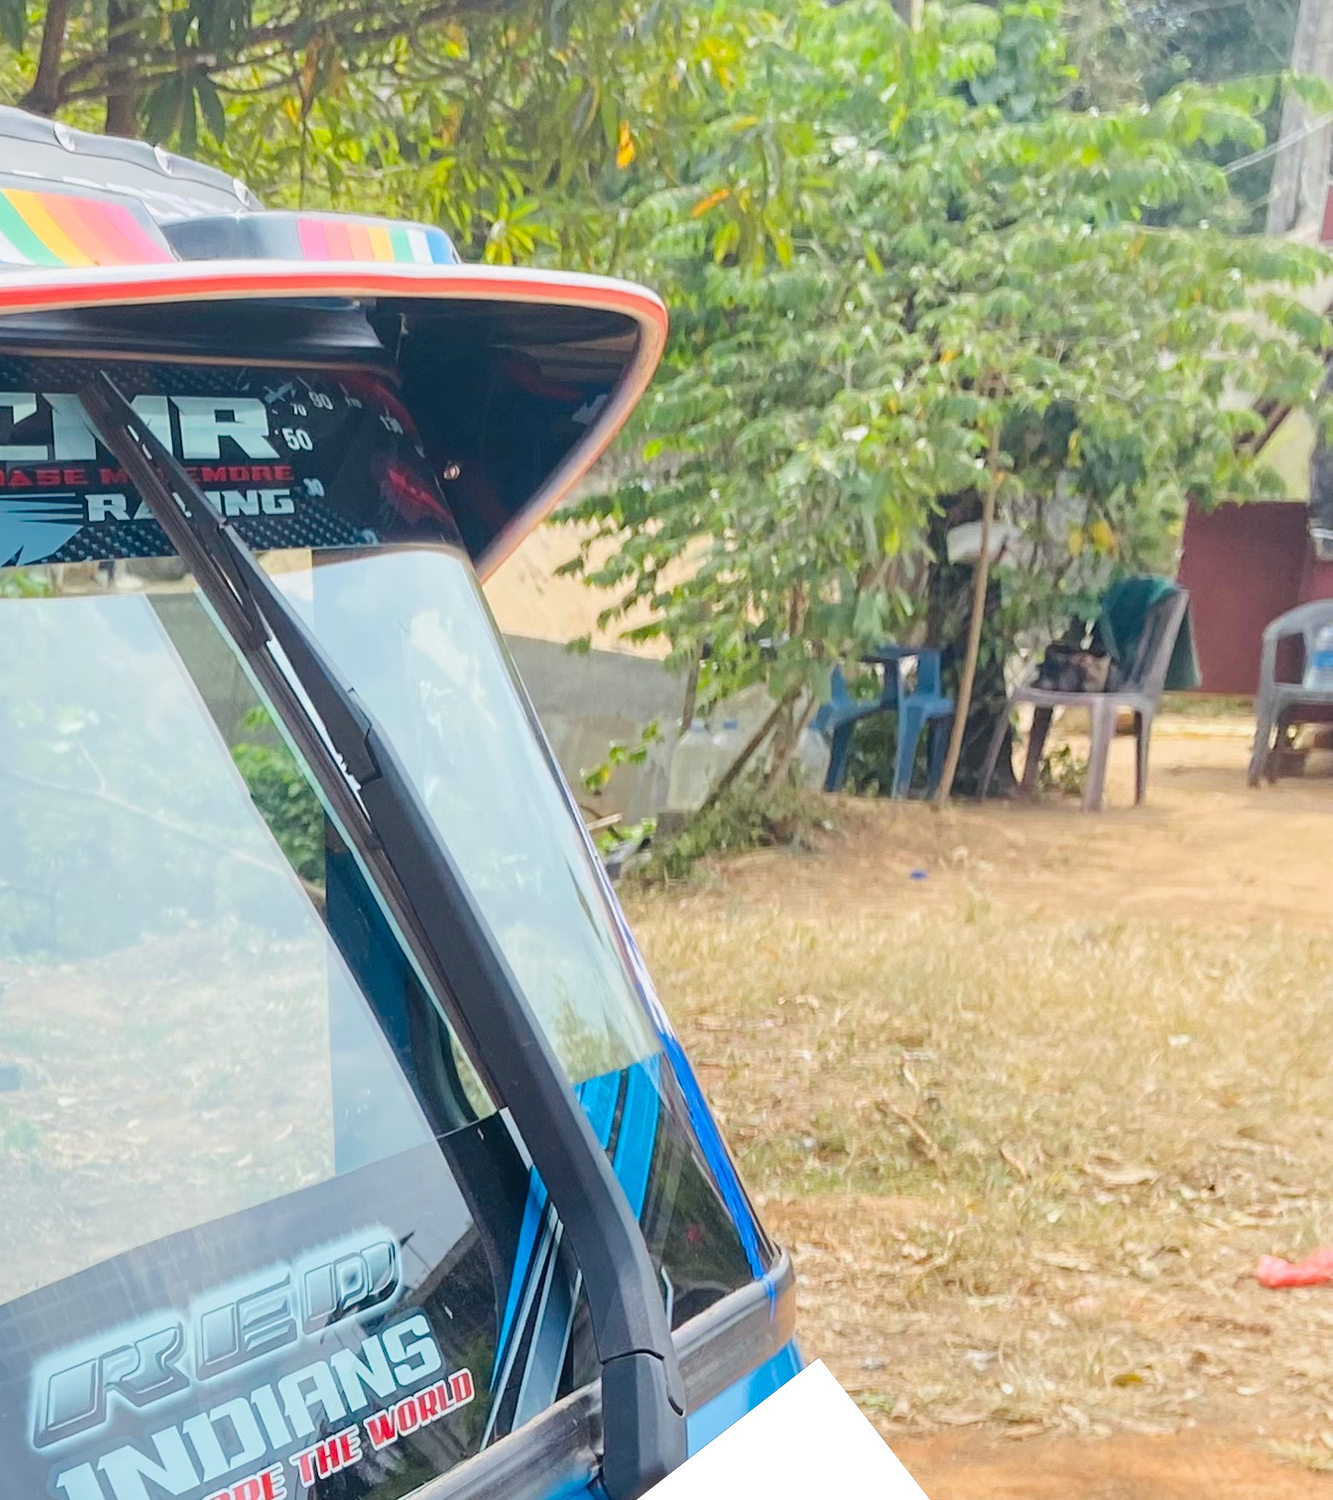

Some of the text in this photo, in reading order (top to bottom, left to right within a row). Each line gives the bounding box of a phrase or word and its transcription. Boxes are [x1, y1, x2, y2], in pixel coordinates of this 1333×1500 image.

[282, 428, 313, 451] 50
[100, 465, 295, 486] MEMORE
[84, 488, 295, 522] RAING
[31, 1238, 401, 1450] RED
[289, 1424, 361, 1488] THE
[364, 1367, 474, 1450] WORLD
